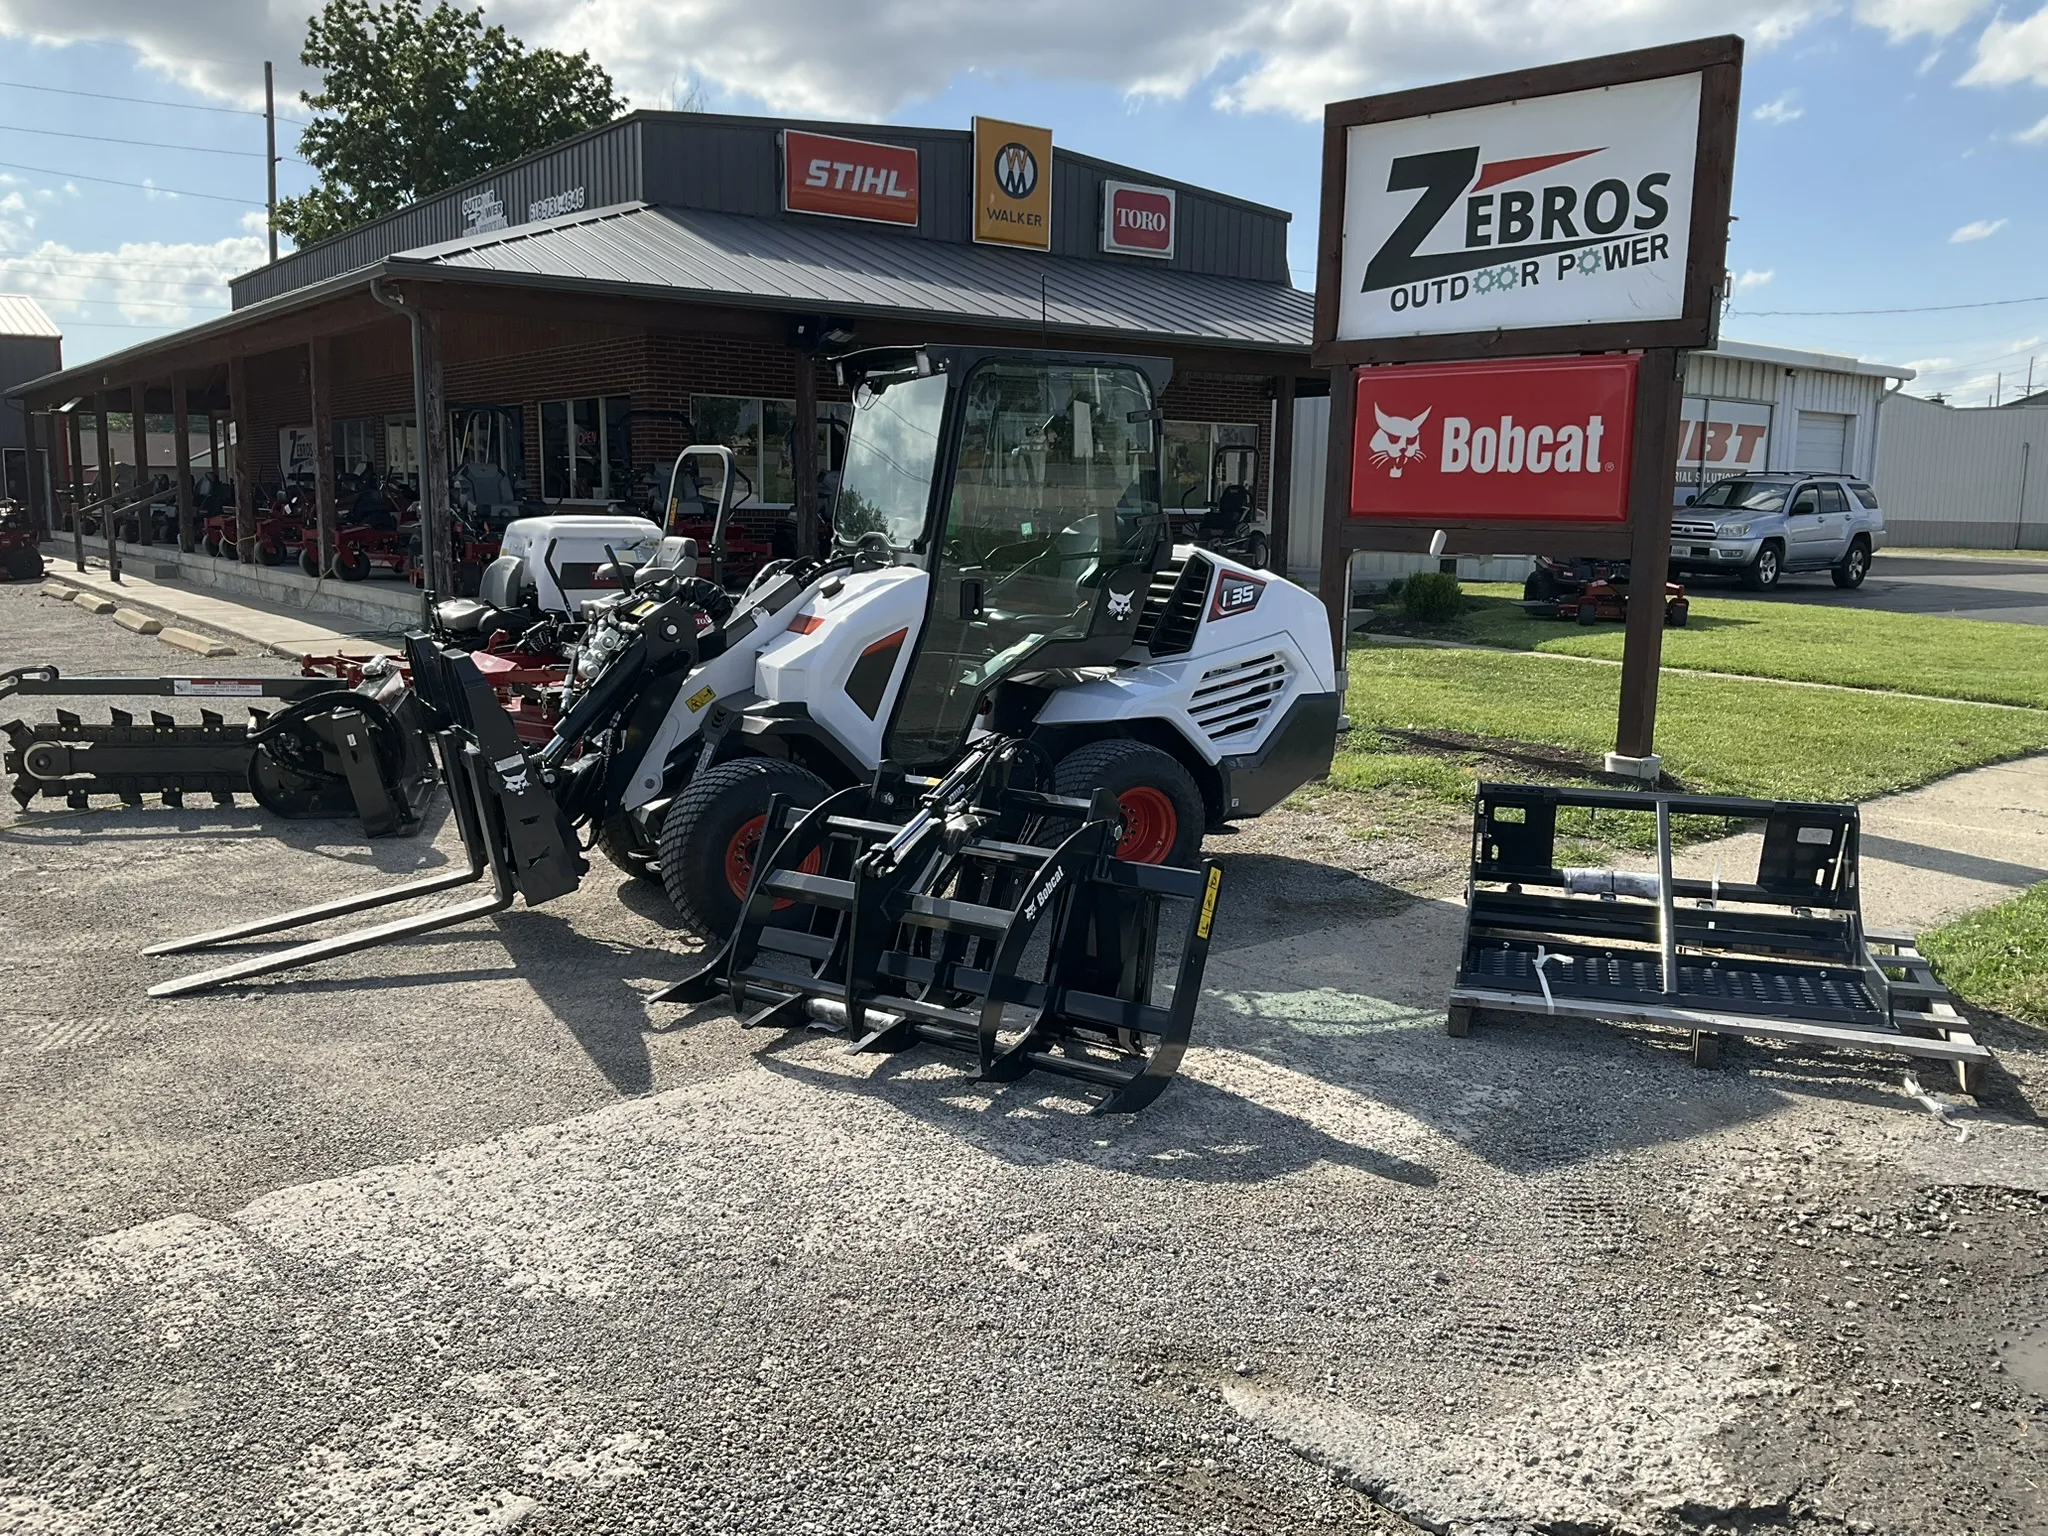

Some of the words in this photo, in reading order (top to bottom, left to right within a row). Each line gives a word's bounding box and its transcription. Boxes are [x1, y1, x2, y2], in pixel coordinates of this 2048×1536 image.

[805, 158, 908, 199] STIHL
[463, 190, 494, 213] OUTDR
[476, 202, 502, 221] PWER
[987, 207, 1043, 228] WALKER
[1116, 207, 1166, 233] TORO
[1361, 146, 1671, 293] ZEBROS
[1558, 233, 1670, 281] POWER
[1440, 415, 1605, 473] Bobcat
[1036, 865, 1064, 907] Bobcat
